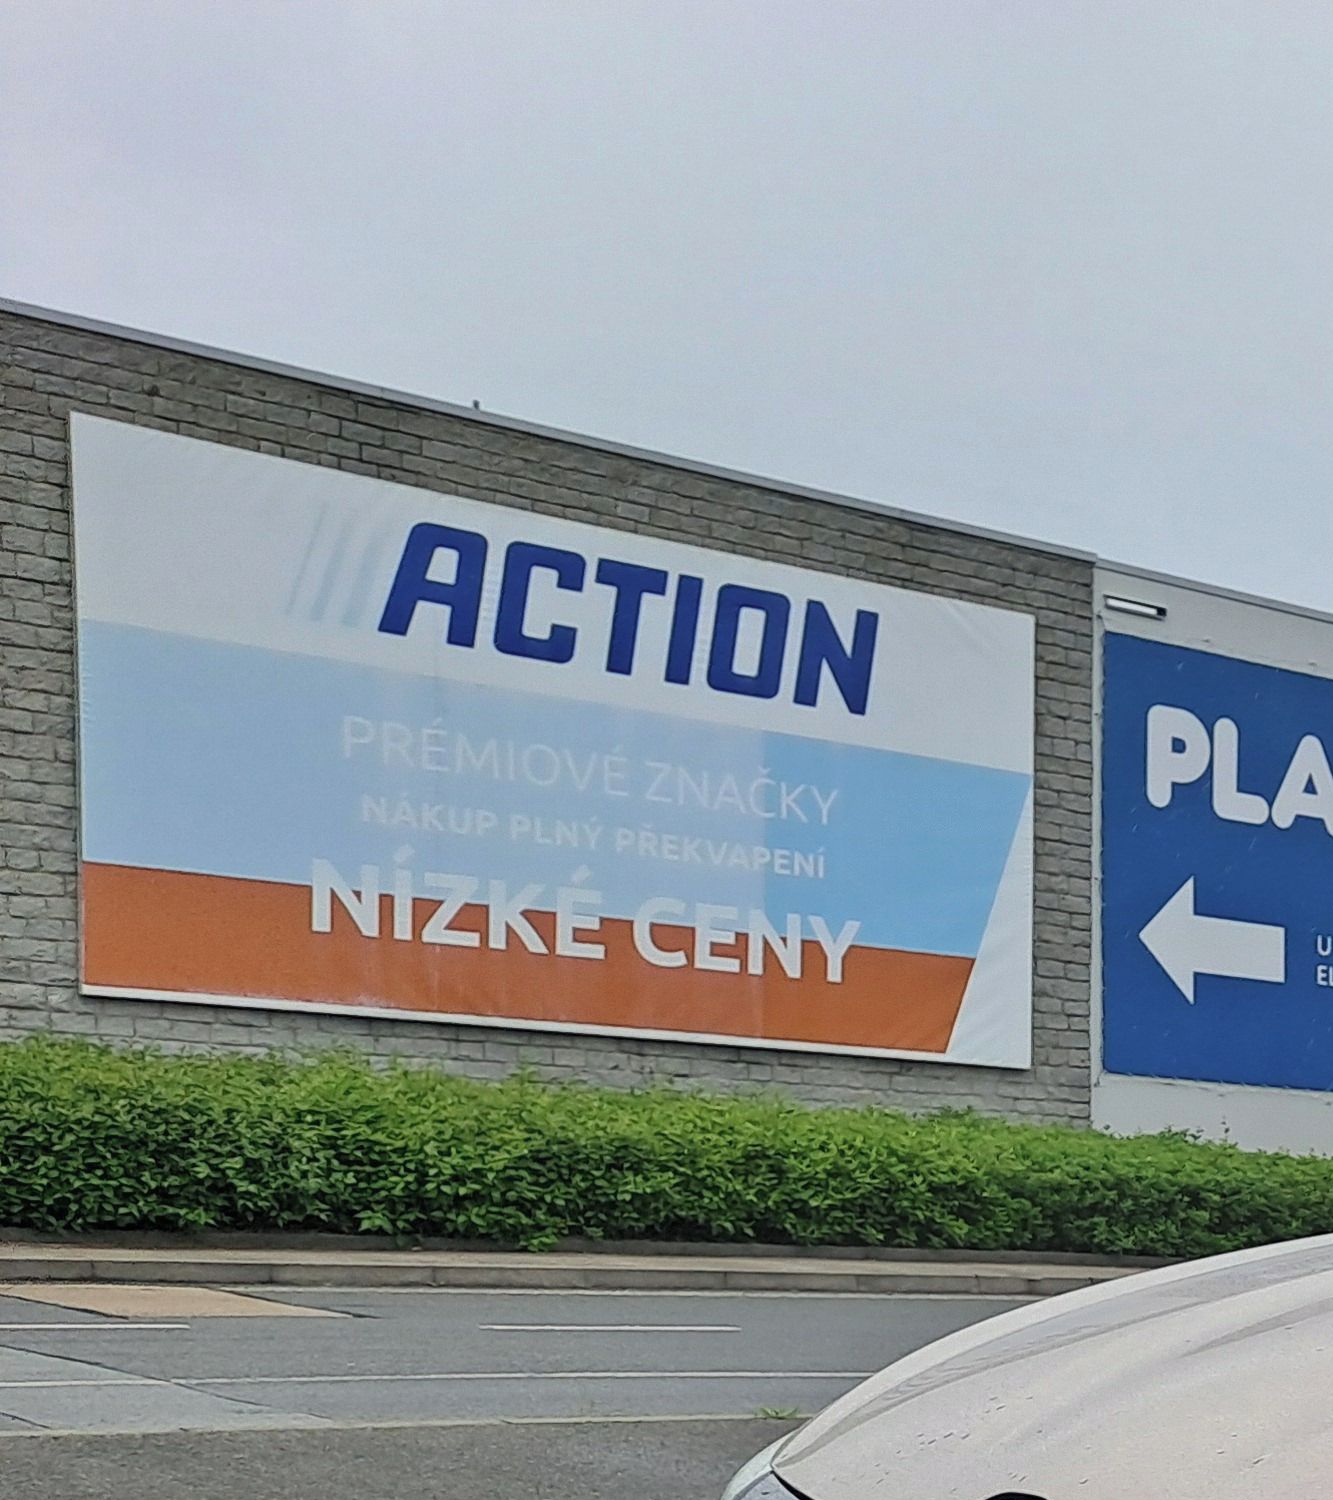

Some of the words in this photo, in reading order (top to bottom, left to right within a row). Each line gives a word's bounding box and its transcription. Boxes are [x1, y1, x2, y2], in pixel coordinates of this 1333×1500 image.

[378, 521, 878, 715] ACTION
[342, 715, 629, 798] PRÉMIOVÉ
[644, 761, 839, 825] ZNAČKY
[361, 794, 497, 837] NÁKUP
[511, 814, 600, 850] PLNÝ
[616, 823, 826, 880] PŘEKVAPENÍ
[311, 844, 606, 960] NÍZKÉ
[632, 895, 862, 984] CENY
[1317, 935, 1332, 956] U
